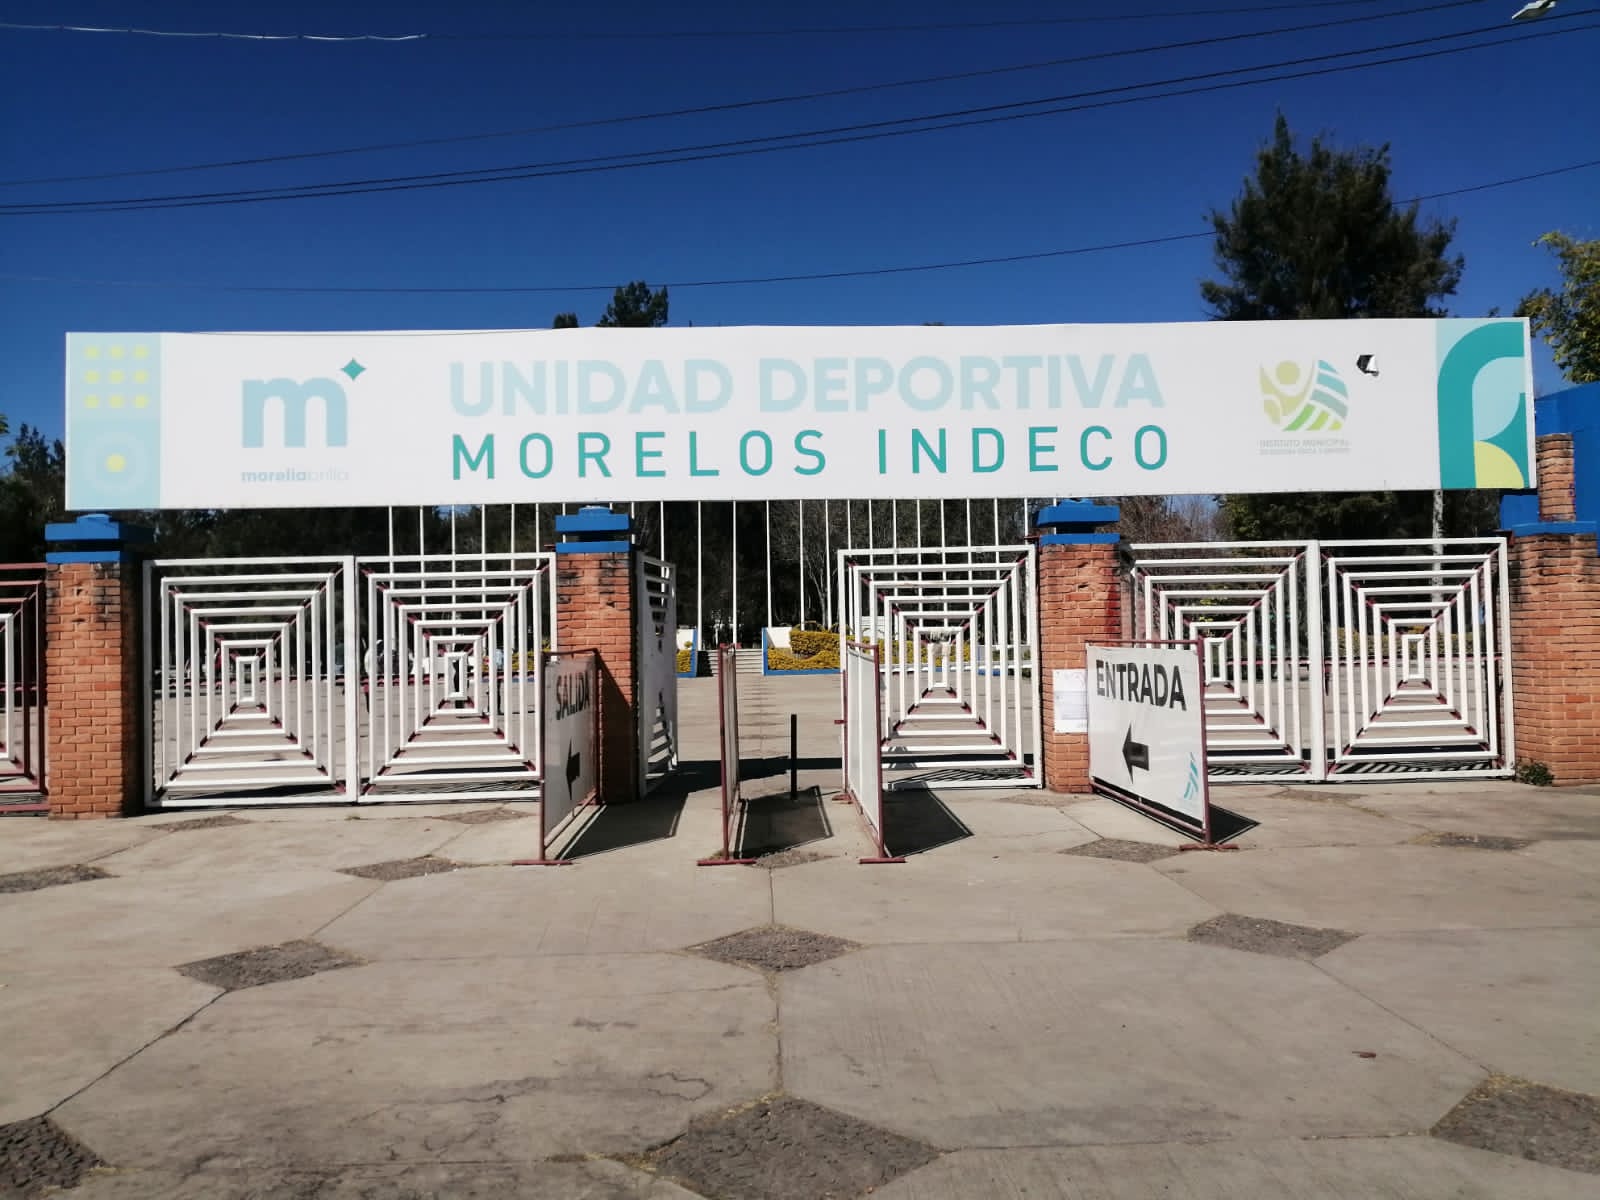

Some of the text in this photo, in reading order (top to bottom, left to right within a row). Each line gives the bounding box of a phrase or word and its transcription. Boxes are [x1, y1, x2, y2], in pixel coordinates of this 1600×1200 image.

[449, 353, 1166, 416] UNIDAD DEPORTIVA
[452, 424, 1168, 480] MORELOS INDECO
[556, 671, 591, 721] SALIDA
[1096, 659, 1187, 711] ENTRADA
